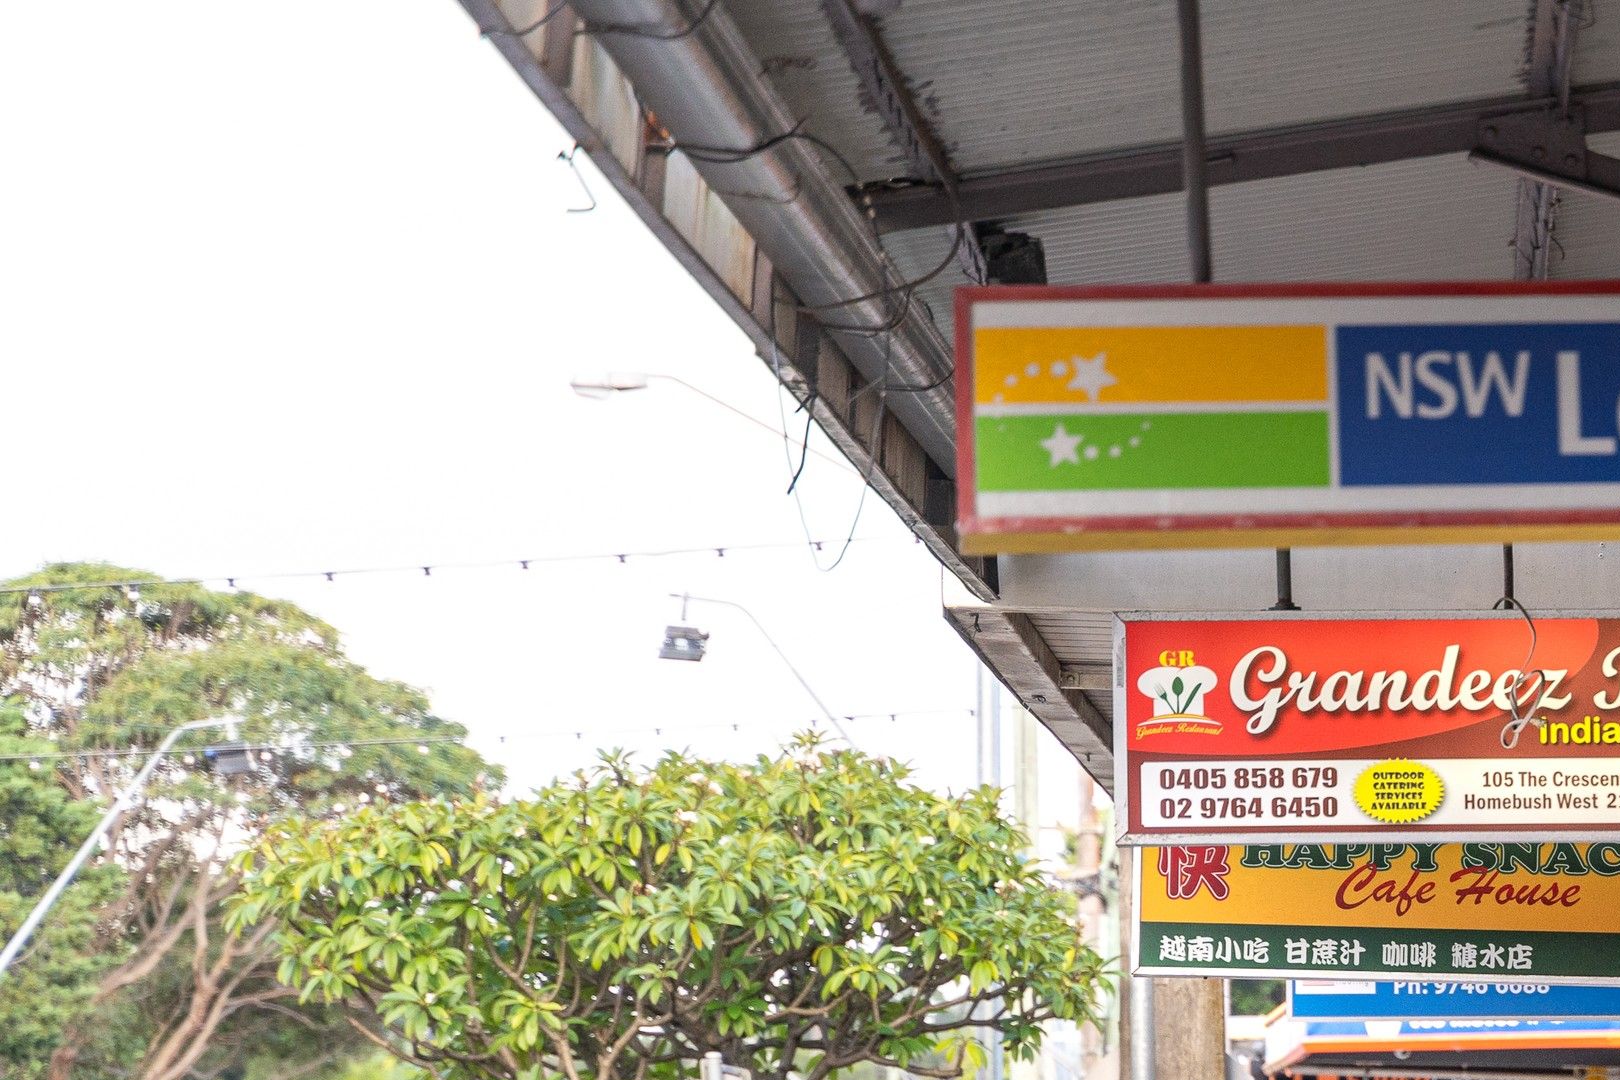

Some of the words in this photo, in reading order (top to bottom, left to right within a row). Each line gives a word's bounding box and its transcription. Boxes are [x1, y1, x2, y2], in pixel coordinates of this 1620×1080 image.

[1365, 351, 1530, 419] NSW
[1159, 650, 1196, 667] GR
[1230, 644, 1572, 735] Grandeez
[1160, 768, 1226, 789] 0405
[1234, 768, 1284, 788] 858
[1292, 767, 1338, 788] 679
[1372, 772, 1424, 780] OUTDOOR
[1482, 772, 1513, 787] 105
[1518, 772, 1547, 787] The
[1373, 782, 1425, 790] CATERING
[1375, 792, 1423, 800] SERVICES
[1464, 794, 1551, 809] Homebush
[1557, 793, 1598, 809] West
[1160, 798, 1192, 819] 02
[1200, 798, 1263, 818] 9764
[1271, 797, 1338, 817] 6450
[1371, 802, 1427, 811] AVAILABLE
[1336, 863, 1435, 916] Cafe
[1449, 865, 1581, 908] House
[1159, 935, 1269, 963] 越南小吃
[1284, 938, 1367, 966] 甘蔗汁
[1382, 941, 1436, 968] 咖啡
[1451, 943, 1533, 970] 糖水店
